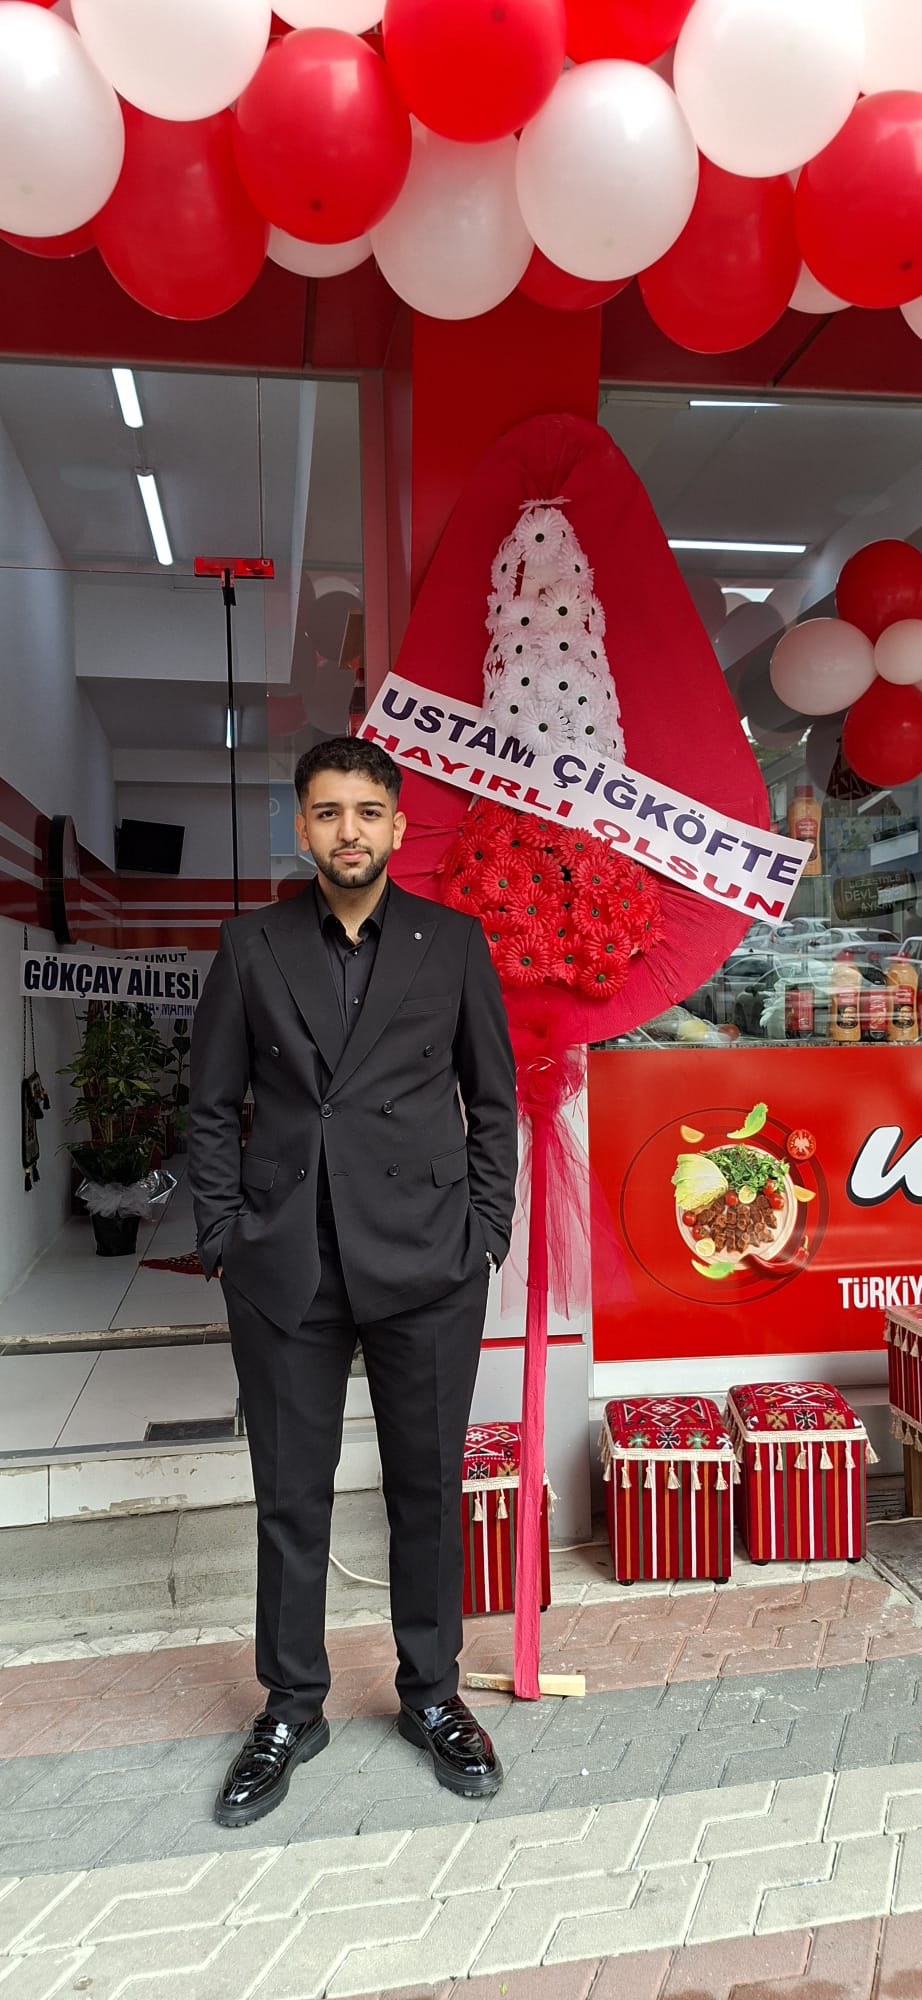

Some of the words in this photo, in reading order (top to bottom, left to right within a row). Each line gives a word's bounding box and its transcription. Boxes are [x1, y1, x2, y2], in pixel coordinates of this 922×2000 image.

[362, 724, 575, 819] HAYIRLI
[593, 818, 789, 919] OLSUN
[382, 688, 537, 769] USTAM
[552, 754, 803, 886] ÇİĞKÖFTE
[24, 955, 123, 998] GÖKÇAY
[127, 964, 199, 1000] AİLESİ
